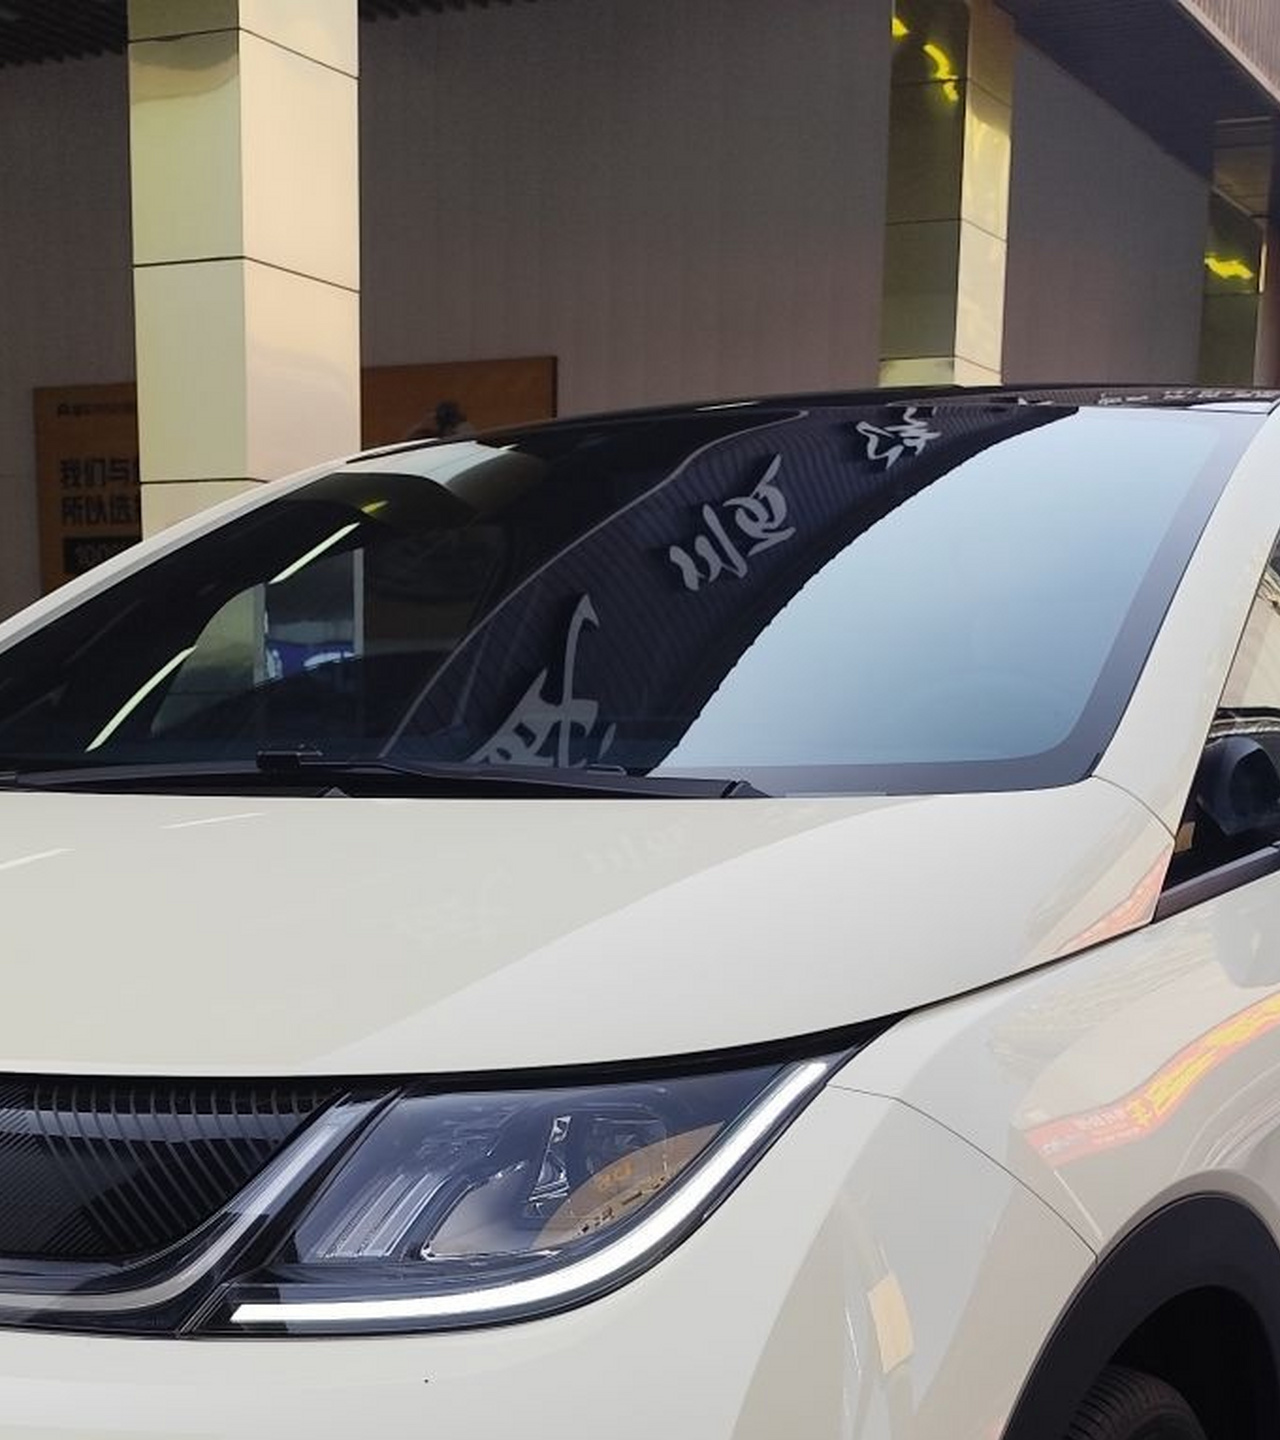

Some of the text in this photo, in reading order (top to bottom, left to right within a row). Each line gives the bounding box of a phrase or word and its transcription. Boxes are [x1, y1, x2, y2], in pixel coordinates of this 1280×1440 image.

[60, 458, 138, 489] 我们与
[61, 494, 139, 527] 所以选
